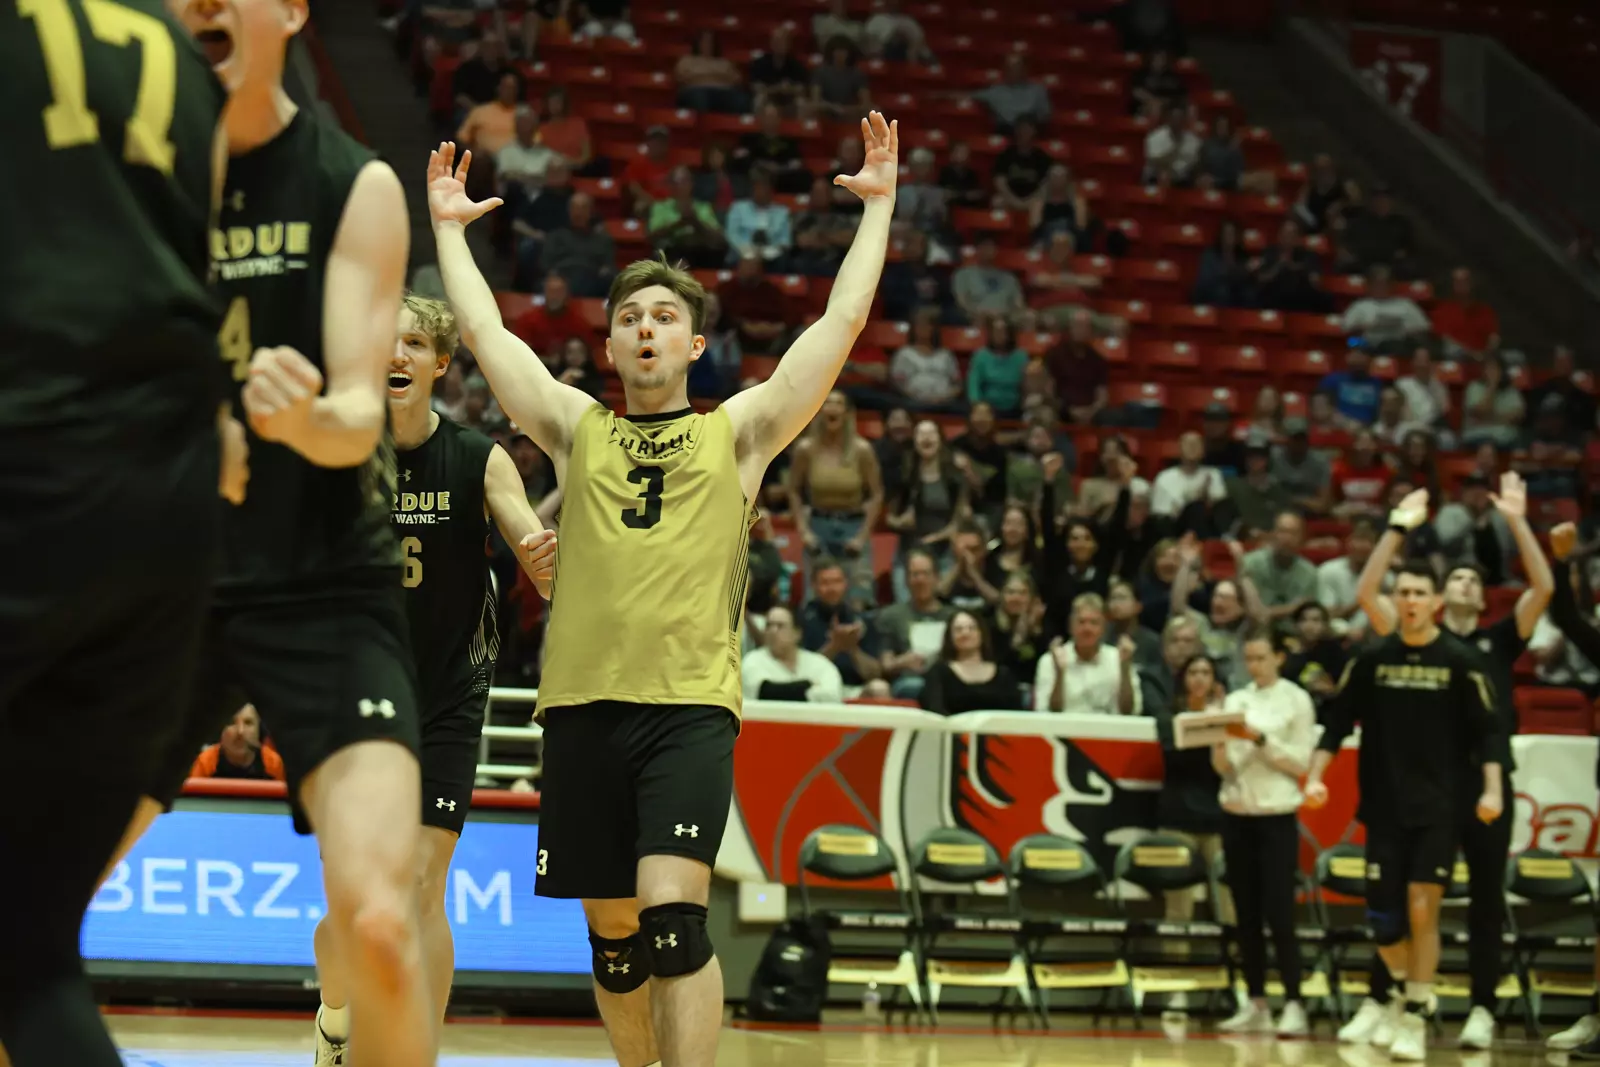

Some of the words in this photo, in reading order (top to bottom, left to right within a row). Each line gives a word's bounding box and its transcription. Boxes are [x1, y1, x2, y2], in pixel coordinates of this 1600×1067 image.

[16, 0, 177, 176] 17
[218, 296, 252, 381] 4
[395, 513, 436, 524] WAYNE
[621, 466, 666, 529] 3
[400, 536, 423, 588] 6
[536, 848, 549, 876] 3
